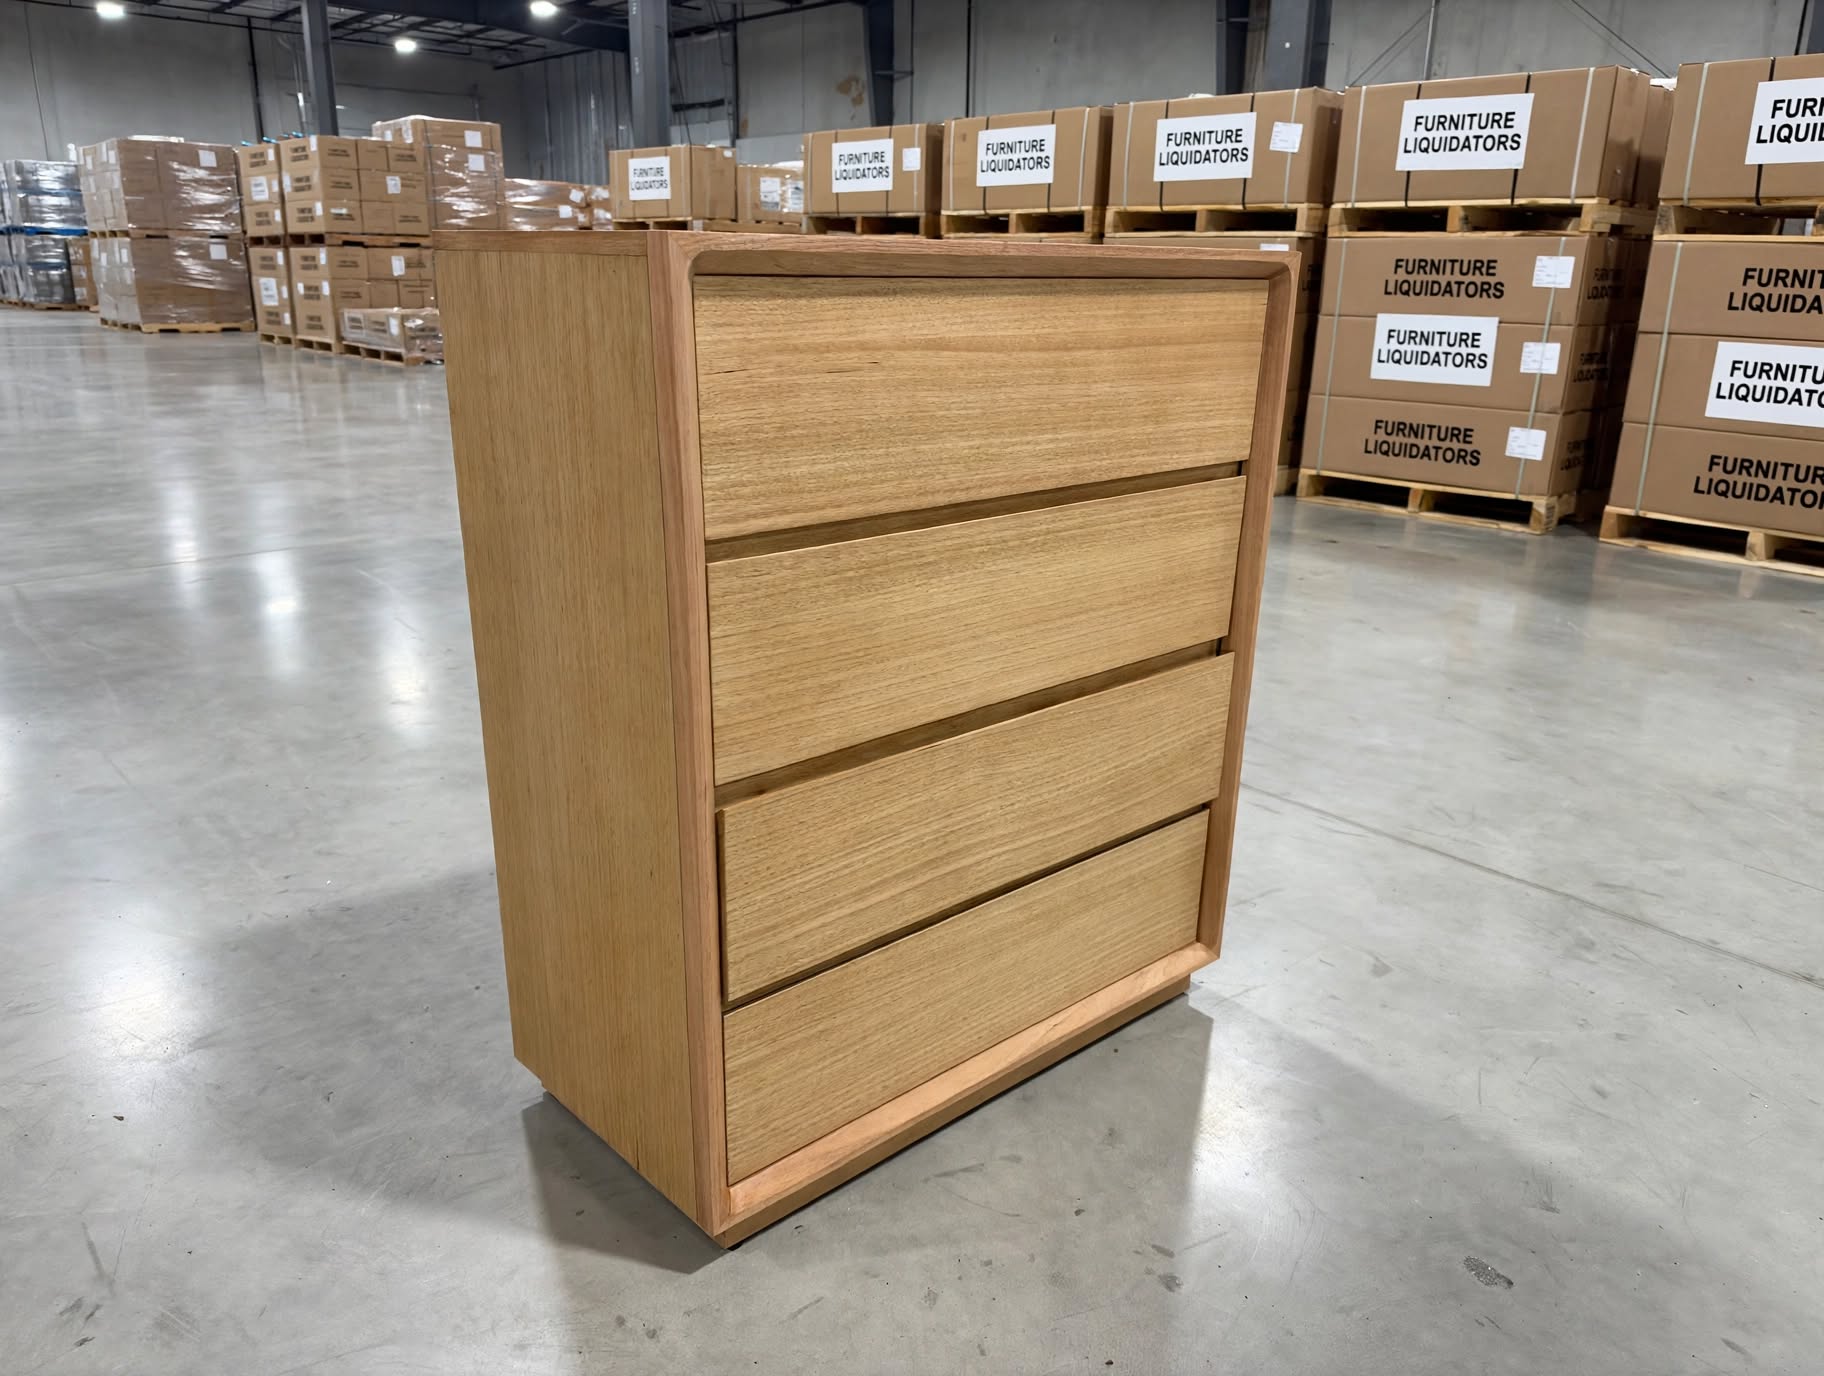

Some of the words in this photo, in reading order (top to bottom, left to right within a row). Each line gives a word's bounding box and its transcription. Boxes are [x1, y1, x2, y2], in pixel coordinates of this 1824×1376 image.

[1413, 111, 1516, 132] FURNITURE
[985, 138, 1046, 156] FURNITURE
[1166, 128, 1243, 147] FURNITURE
[1403, 133, 1522, 154] LIQUIDATORS
[838, 151, 886, 166] FURNITURE
[980, 155, 1051, 173] LIQUIDATORS
[1158, 147, 1249, 166] LIQUIDATORS
[834, 166, 890, 181] LIQUIDATORS
[1393, 258, 1498, 277] FURNITURE
[1383, 279, 1505, 300] LIQUIDATORS
[1727, 291, 1824, 315] LIQUIDA
[1386, 328, 1482, 349] FURNITURE
[1377, 348, 1488, 370] LIQUIDATORS
[1729, 360, 1824, 385] FURNITU
[1373, 419, 1475, 445] FURNITURE
[1363, 438, 1481, 467] LIQUIDATORS
[1708, 454, 1824, 486] FURNITUR
